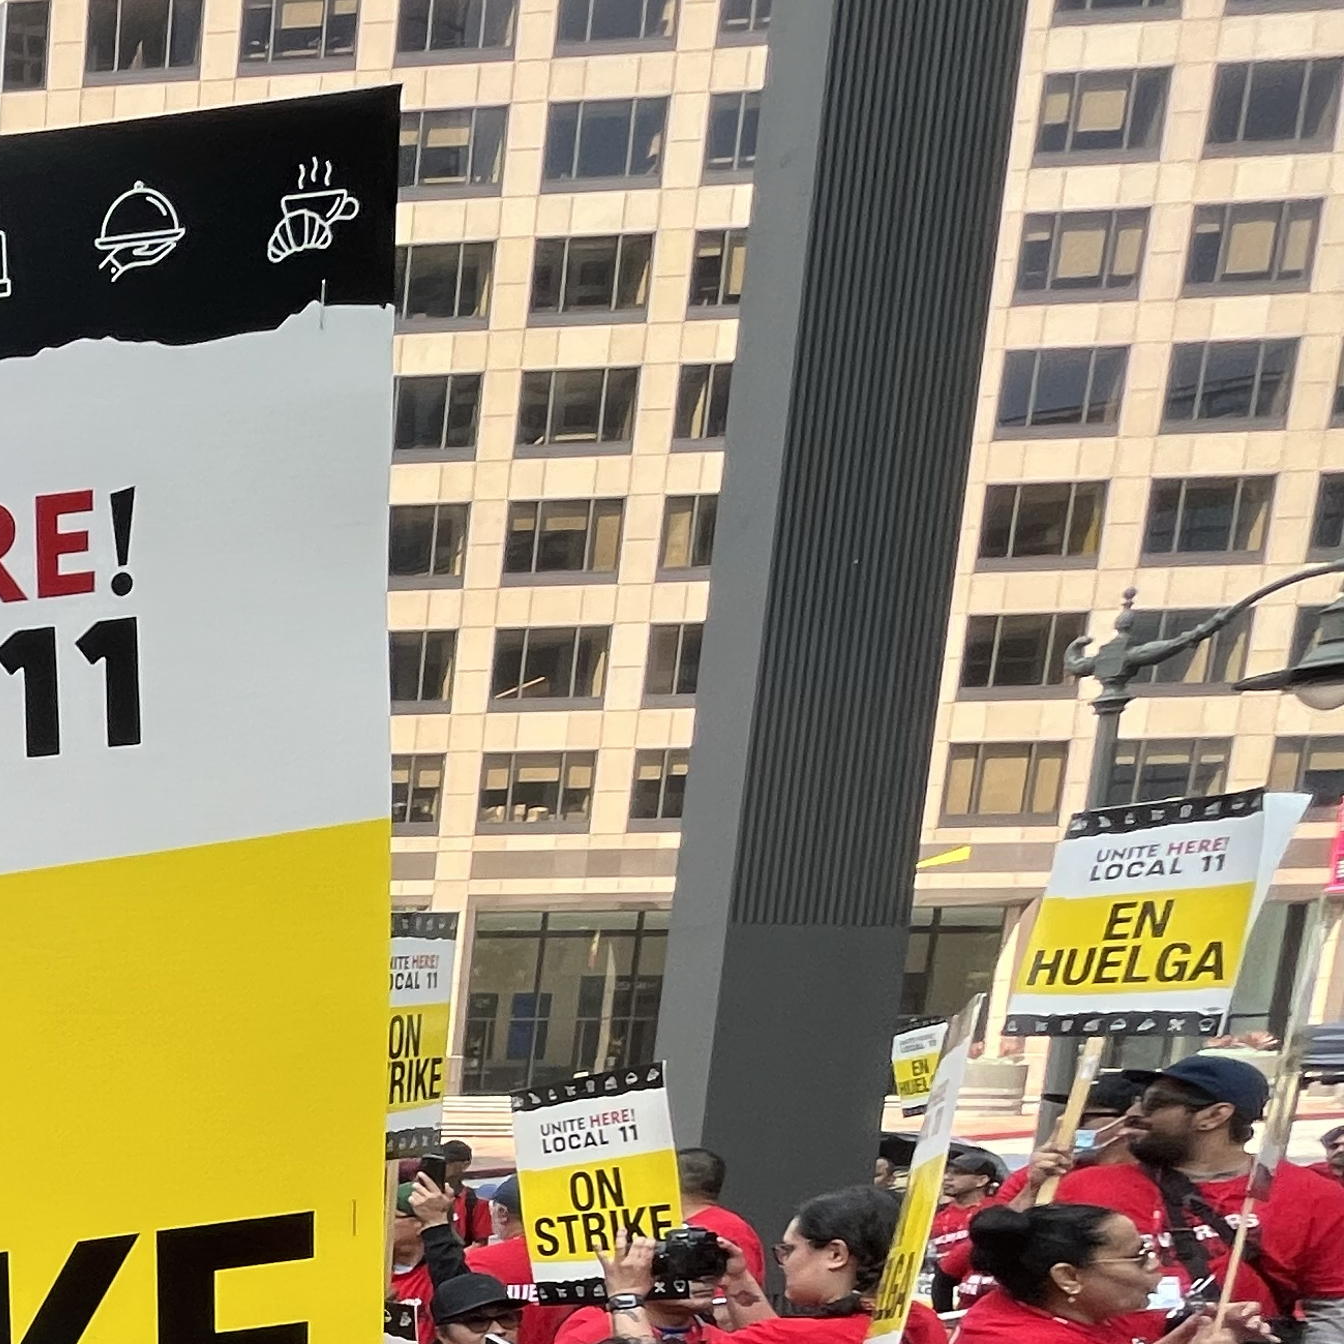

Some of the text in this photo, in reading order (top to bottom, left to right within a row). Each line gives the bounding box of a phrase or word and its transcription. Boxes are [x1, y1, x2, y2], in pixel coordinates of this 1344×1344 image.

[1090, 853, 1226, 881] LOCAL 11
[1096, 836, 1230, 863] UNITE HERE!
[1102, 899, 1176, 941] EN
[390, 956, 410, 970] ITE
[1026, 941, 1224, 987] HUELGA
[390, 972, 439, 991] CAL 11
[389, 1014, 423, 1060] ON
[389, 1056, 443, 1105] RIKE
[540, 1108, 635, 1137] UNITE HERE!
[542, 1124, 639, 1154] LOCAL 11
[570, 1166, 624, 1211] ON
[534, 1203, 672, 1257] STRIKE
